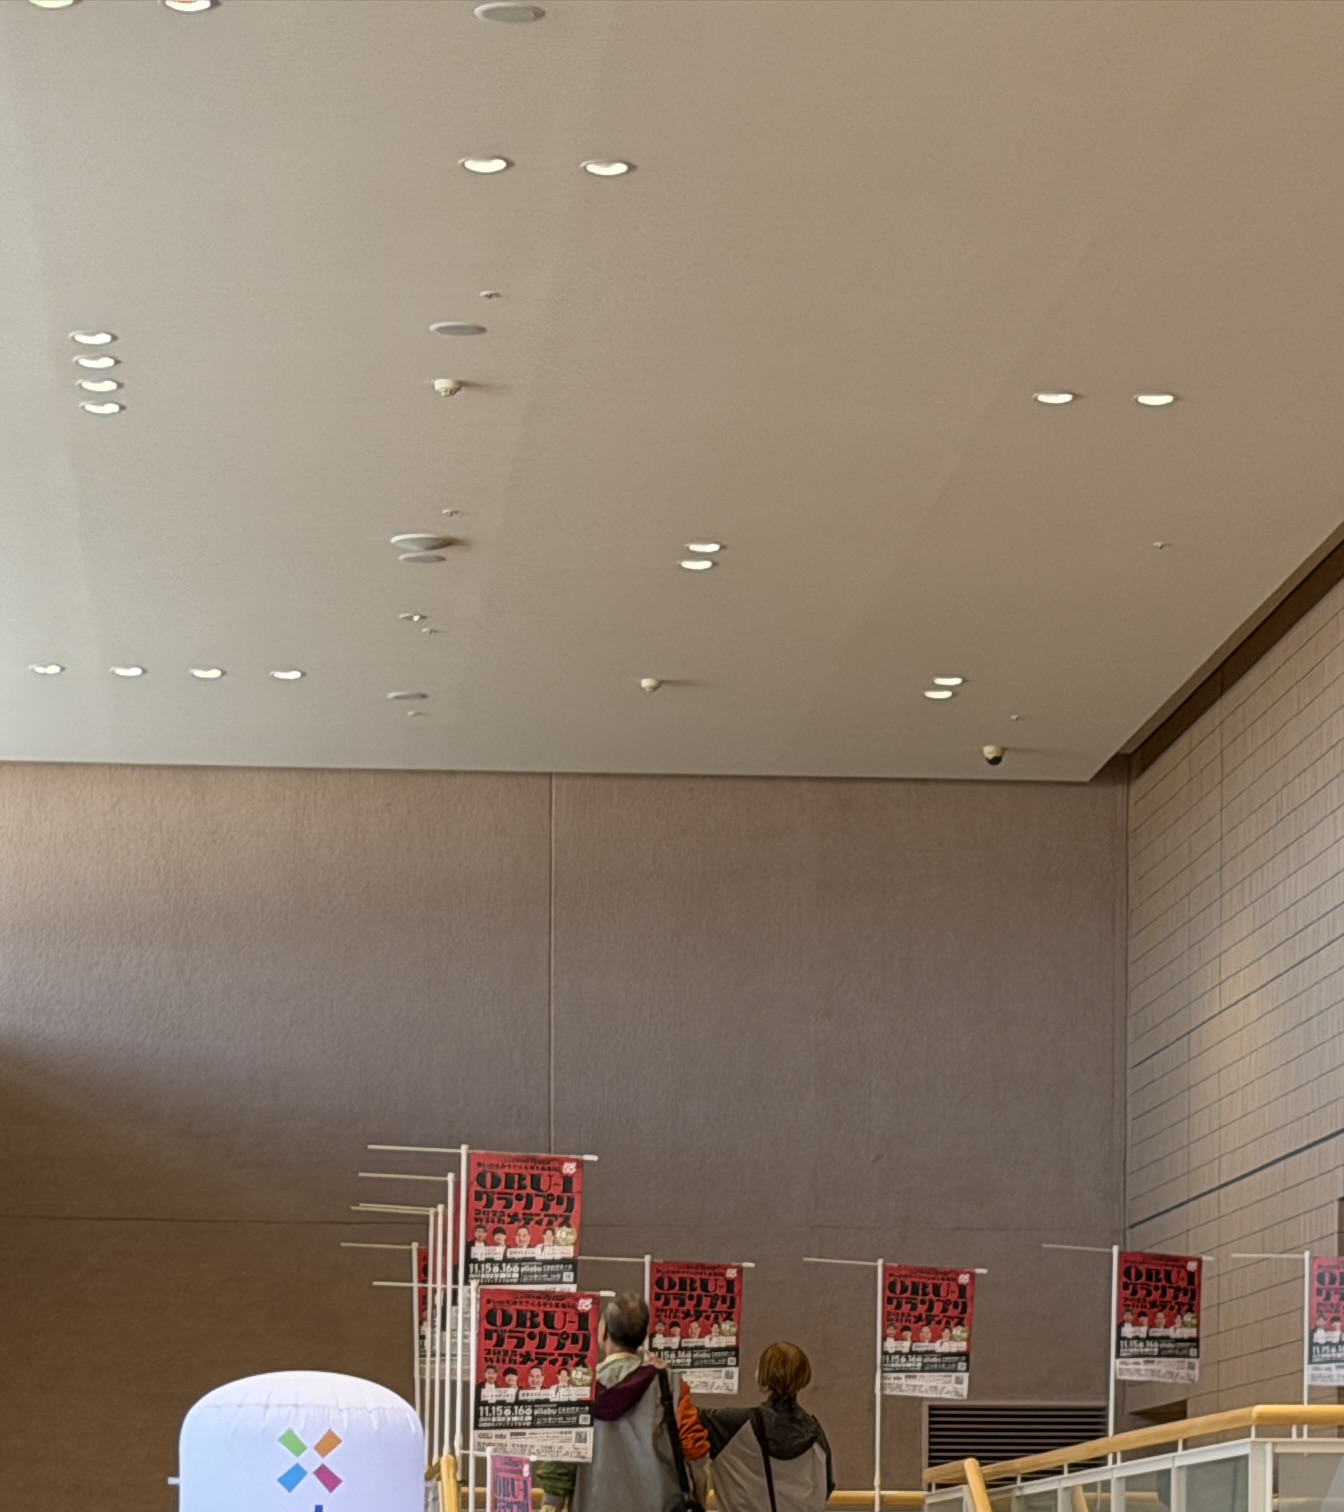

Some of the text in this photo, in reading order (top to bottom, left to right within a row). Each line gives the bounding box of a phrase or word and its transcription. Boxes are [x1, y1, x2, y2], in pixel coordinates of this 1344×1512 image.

[476, 1171, 574, 1193] OBU-1
[474, 1191, 575, 1214] グランプリ
[655, 1276, 735, 1293] OBU-1
[888, 1280, 967, 1299] OBU-1
[485, 1308, 589, 1332] OBU-1
[484, 1330, 591, 1353] グランプリ
[519, 1350, 588, 1368] メディアス
